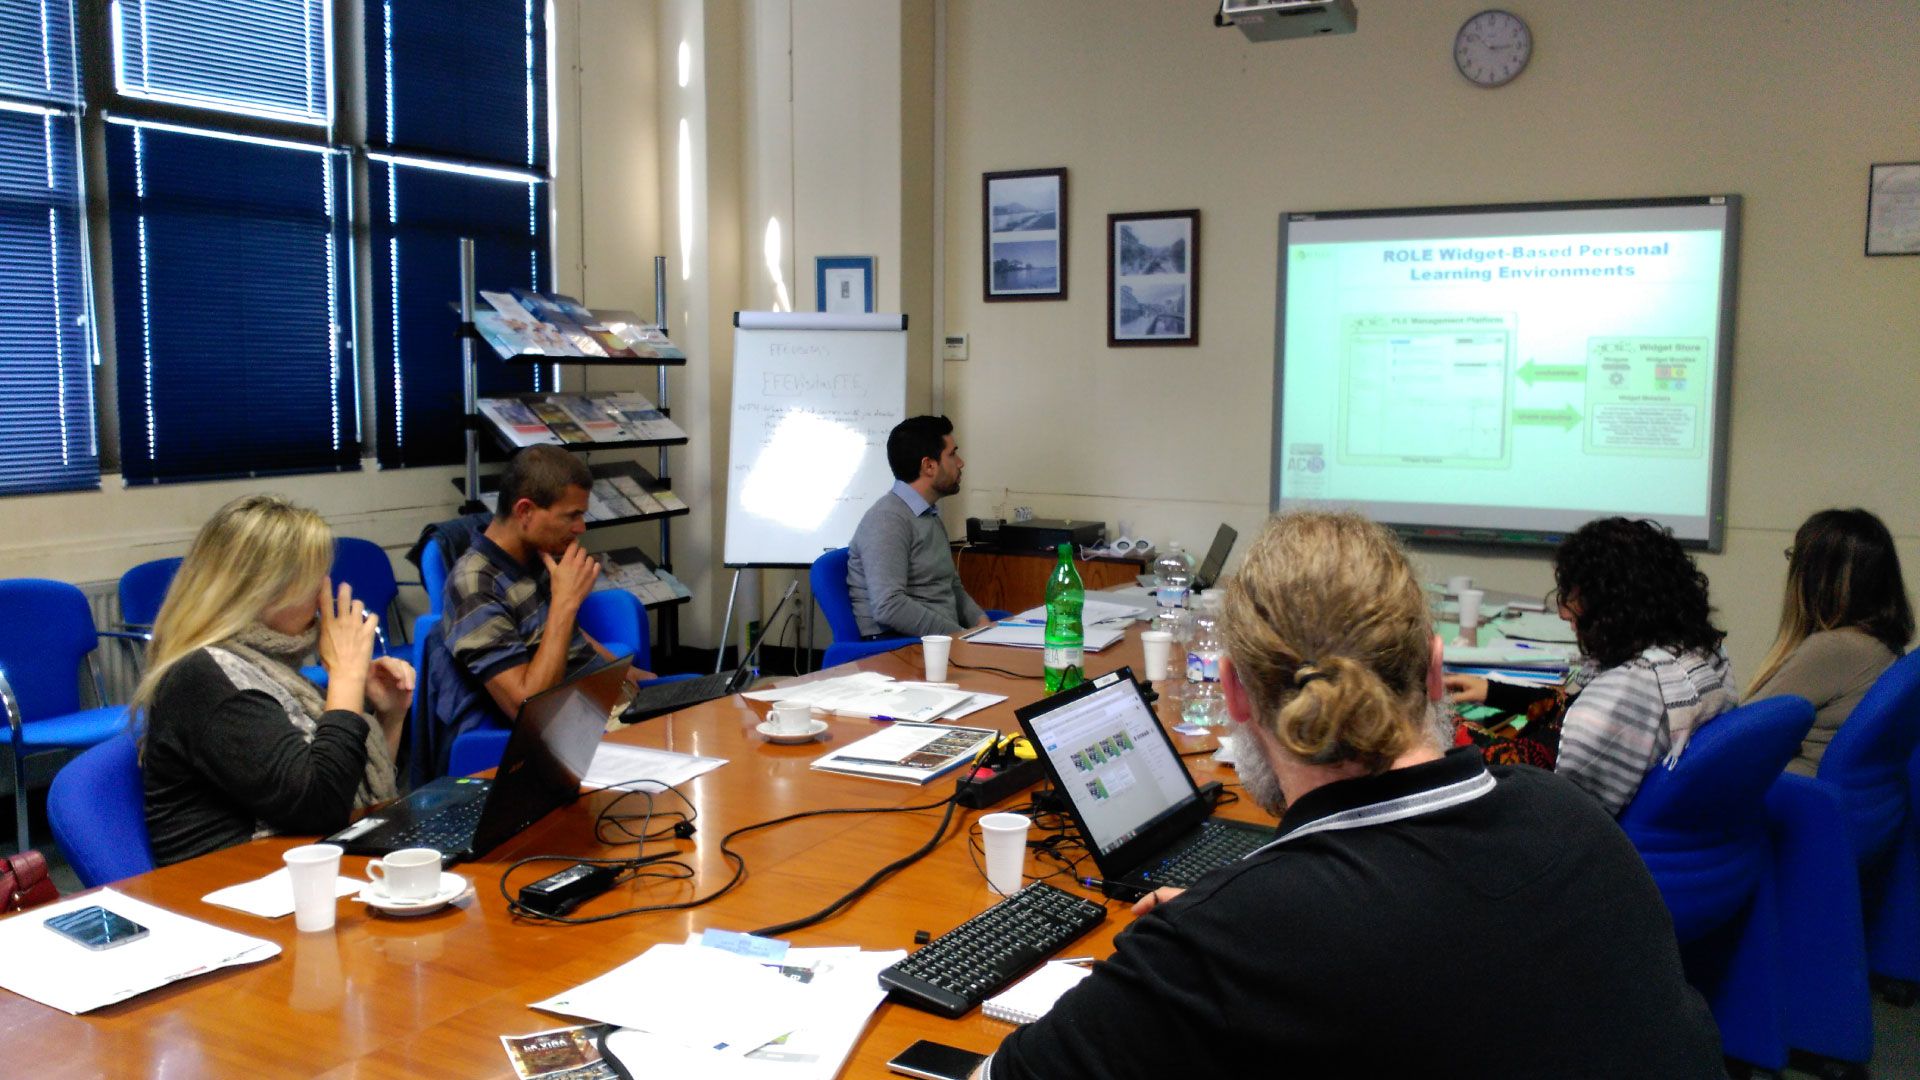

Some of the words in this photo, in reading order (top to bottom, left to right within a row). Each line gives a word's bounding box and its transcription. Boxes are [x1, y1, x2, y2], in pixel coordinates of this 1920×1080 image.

[1383, 249, 1433, 263] ROLE
[1439, 245, 1572, 263] Widget-Based
[1579, 242, 1669, 257] Personal
[1410, 266, 1492, 282] Learning
[1499, 264, 1636, 279] Environments
[1639, 344, 1673, 353] Widget
